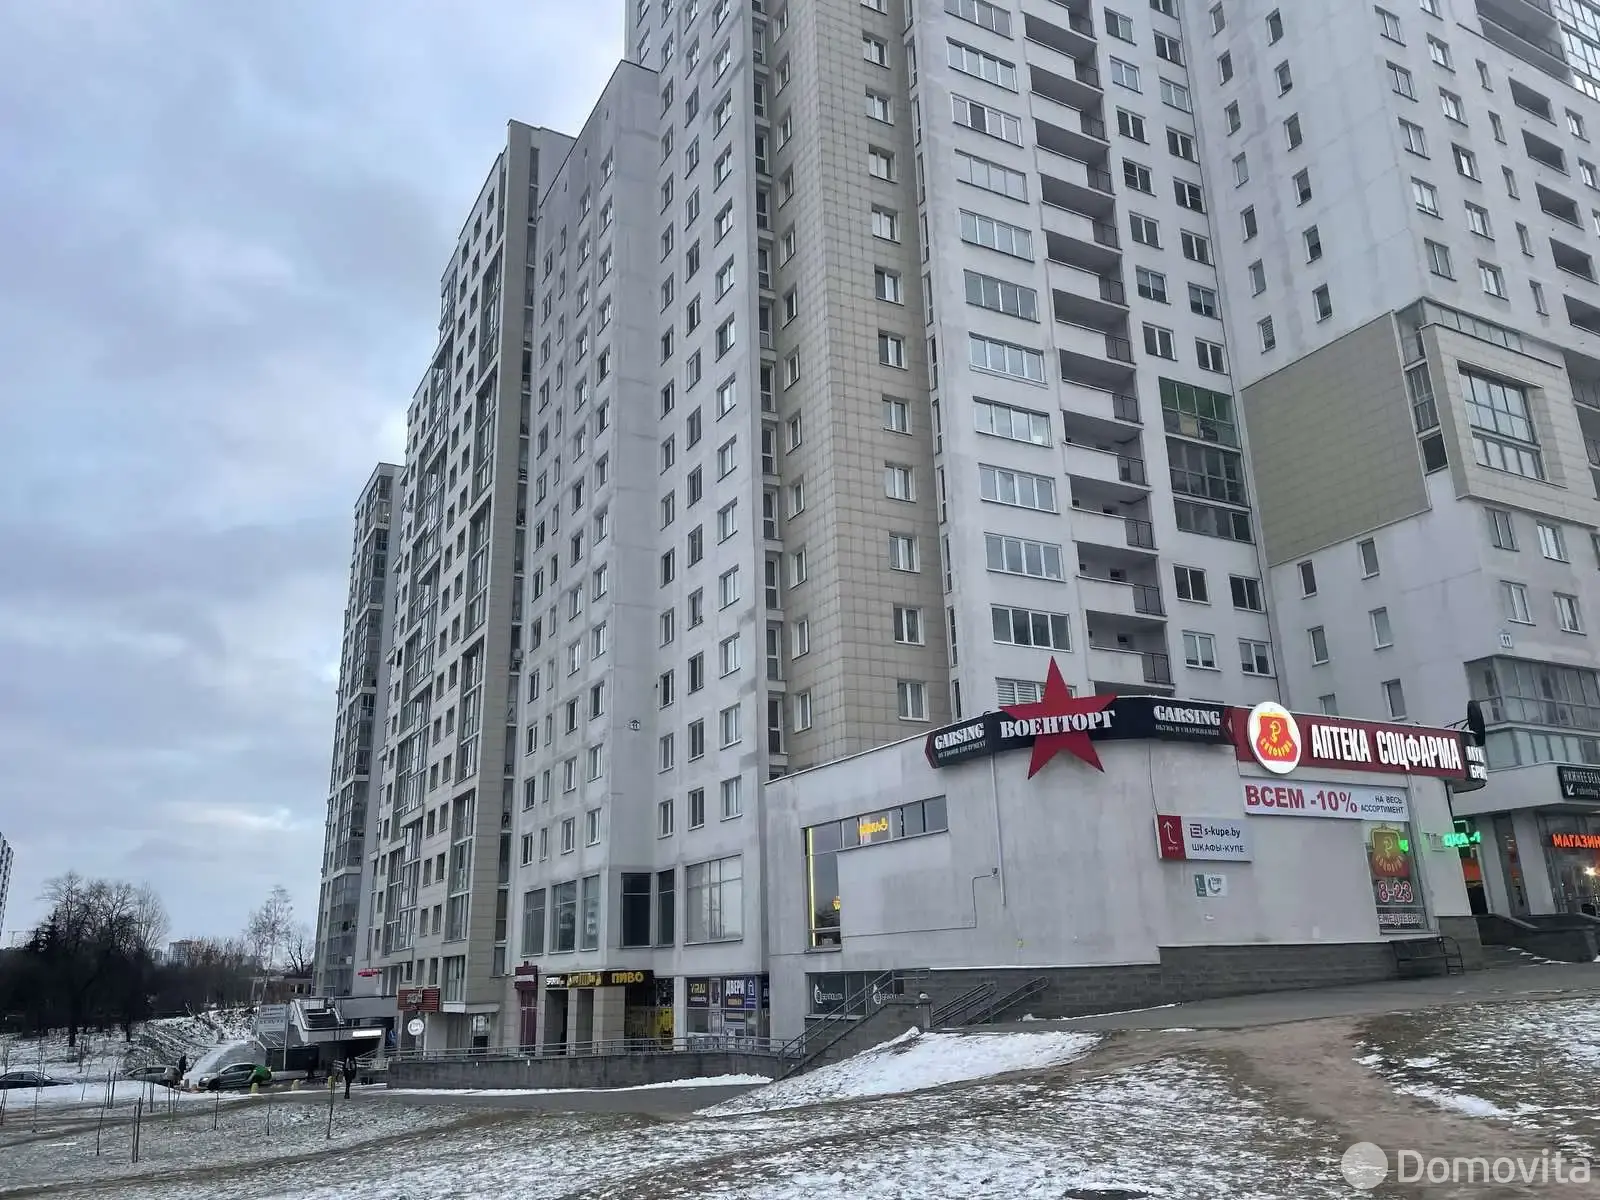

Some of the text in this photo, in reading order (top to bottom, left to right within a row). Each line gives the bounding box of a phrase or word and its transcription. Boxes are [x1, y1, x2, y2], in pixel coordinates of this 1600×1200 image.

[1000, 710, 1116, 738] ВОЕНТОРГ
[1153, 705, 1221, 726] GARSING
[934, 722, 985, 750] GARSING
[1311, 724, 1462, 770] АПТЕКА СОЦФАРМА
[1245, 784, 1358, 813] ВСЕМ -10%
[1375, 795, 1403, 804] НА ВЕСЬ
[1361, 804, 1404, 814] АССОРТИМЕНТ
[1204, 826, 1241, 839] s-kupe.by
[1552, 833, 1600, 849] МАГАЗИН
[1191, 844, 1245, 853] ШКАФЫ-КУПЕ
[1378, 880, 1413, 903] 8-23
[611, 971, 645, 984] ПИВО
[725, 979, 745, 997] ДВЕРИ
